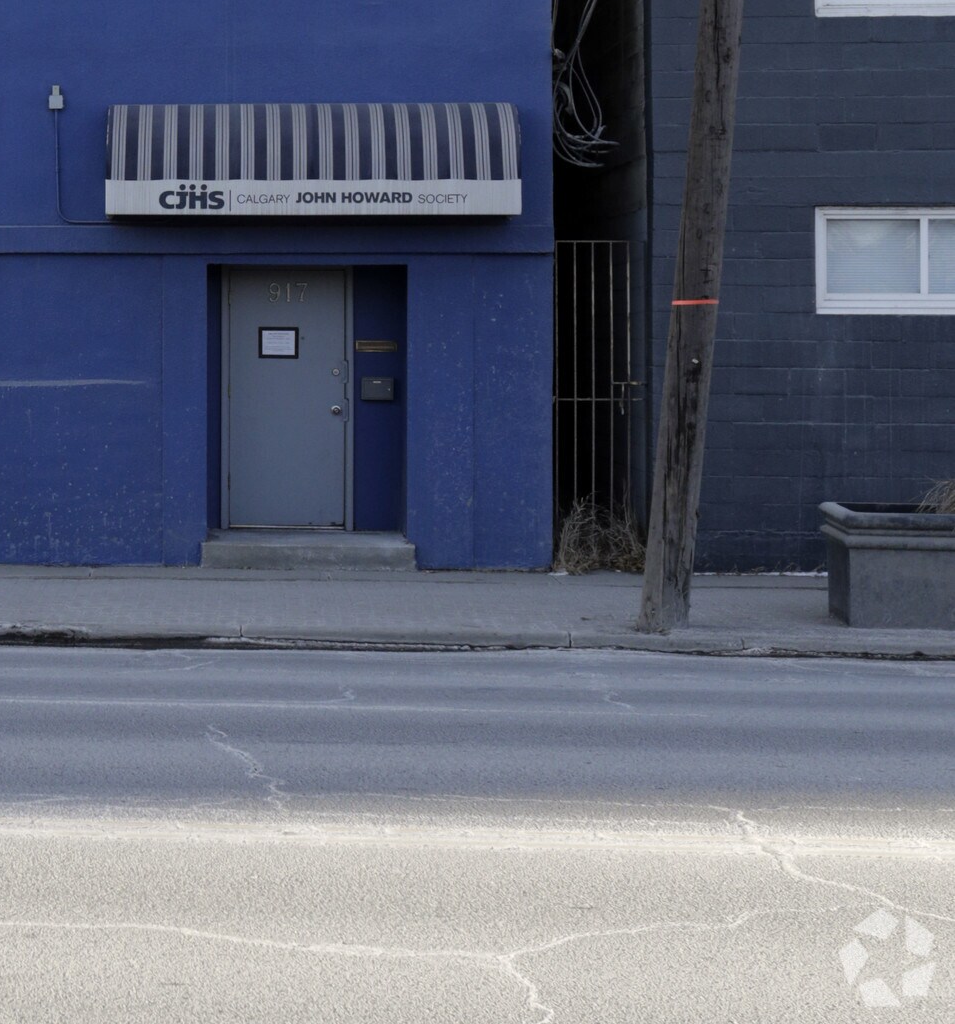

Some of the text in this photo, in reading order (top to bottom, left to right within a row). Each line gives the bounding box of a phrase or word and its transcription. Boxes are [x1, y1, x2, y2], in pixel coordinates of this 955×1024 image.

[158, 184, 468, 210] CJHS CALGARY JOHN HOWARD SOCIETY
[269, 282, 308, 303] 917
